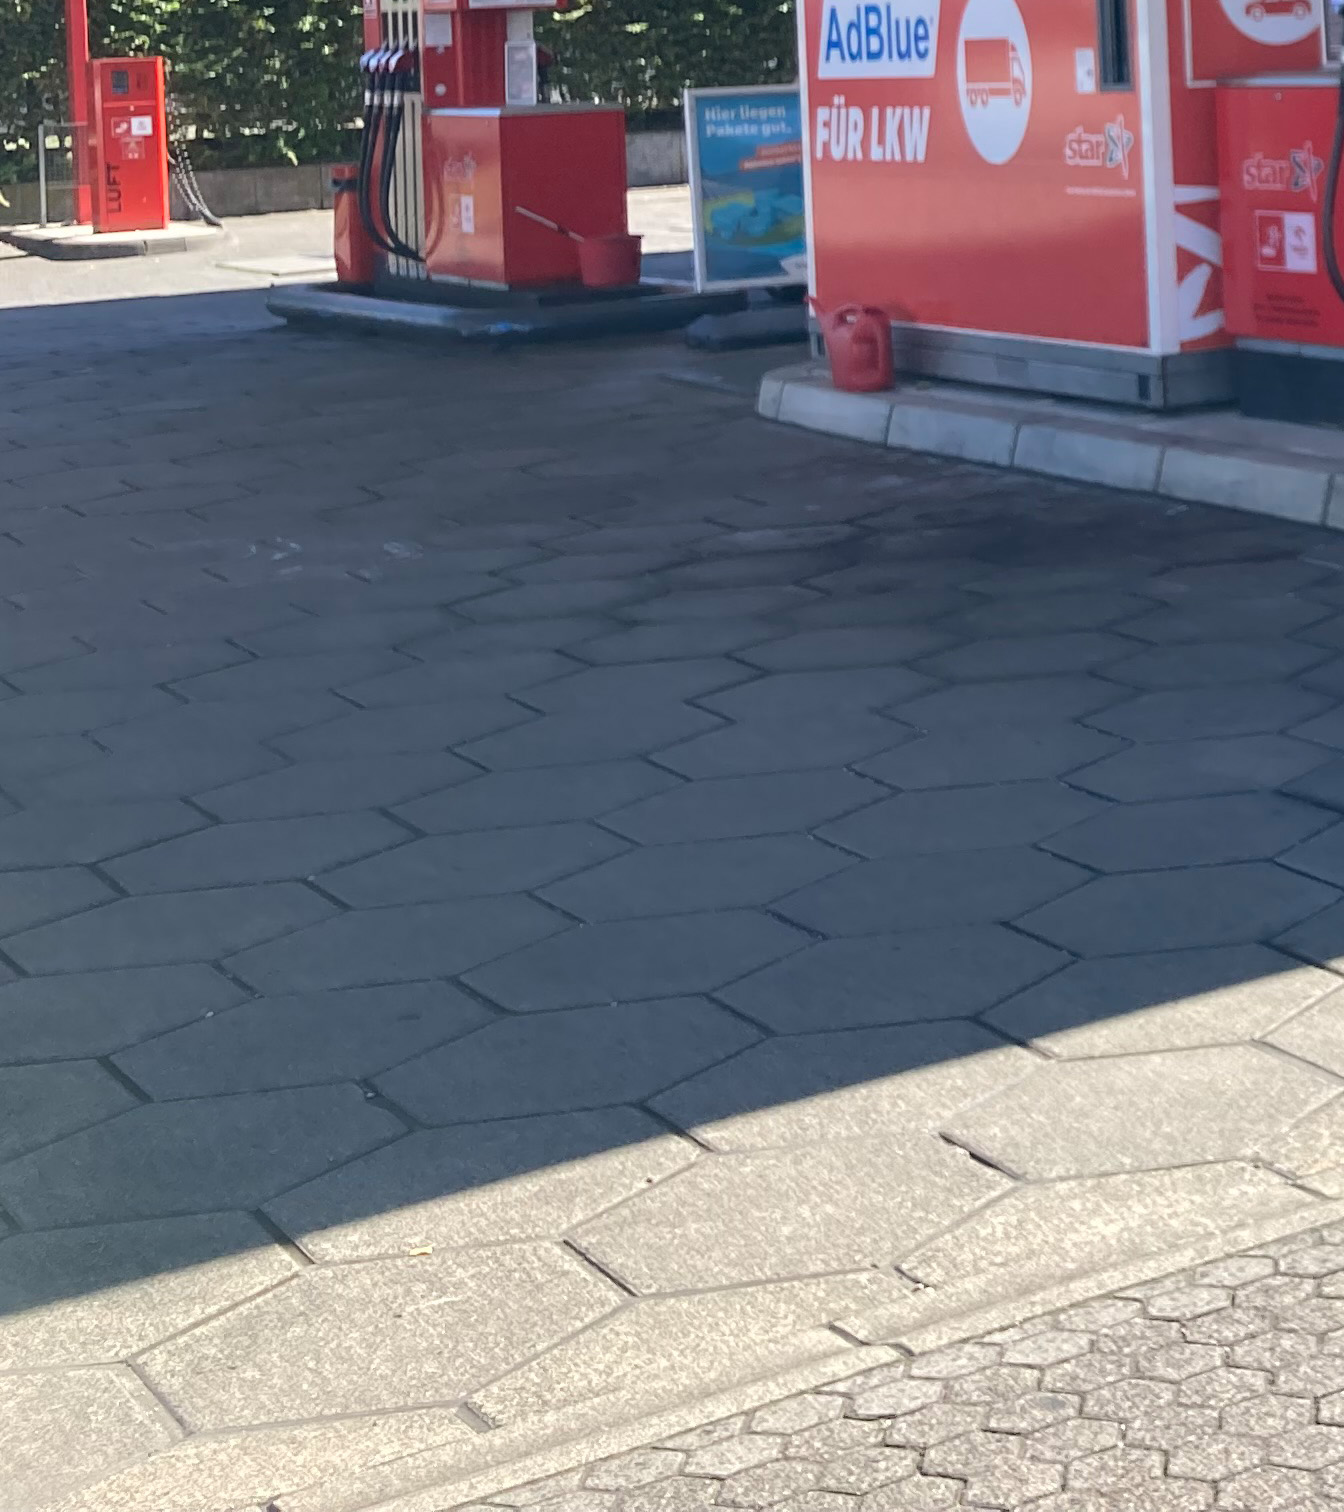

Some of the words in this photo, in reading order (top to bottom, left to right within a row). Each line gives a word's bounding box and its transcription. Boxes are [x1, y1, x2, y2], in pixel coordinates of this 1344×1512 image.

[816, 94, 864, 162] FÜR
[870, 105, 931, 164] LKW
[1064, 125, 1106, 166] star
[105, 161, 121, 214] LUFT
[1242, 152, 1291, 190] star
